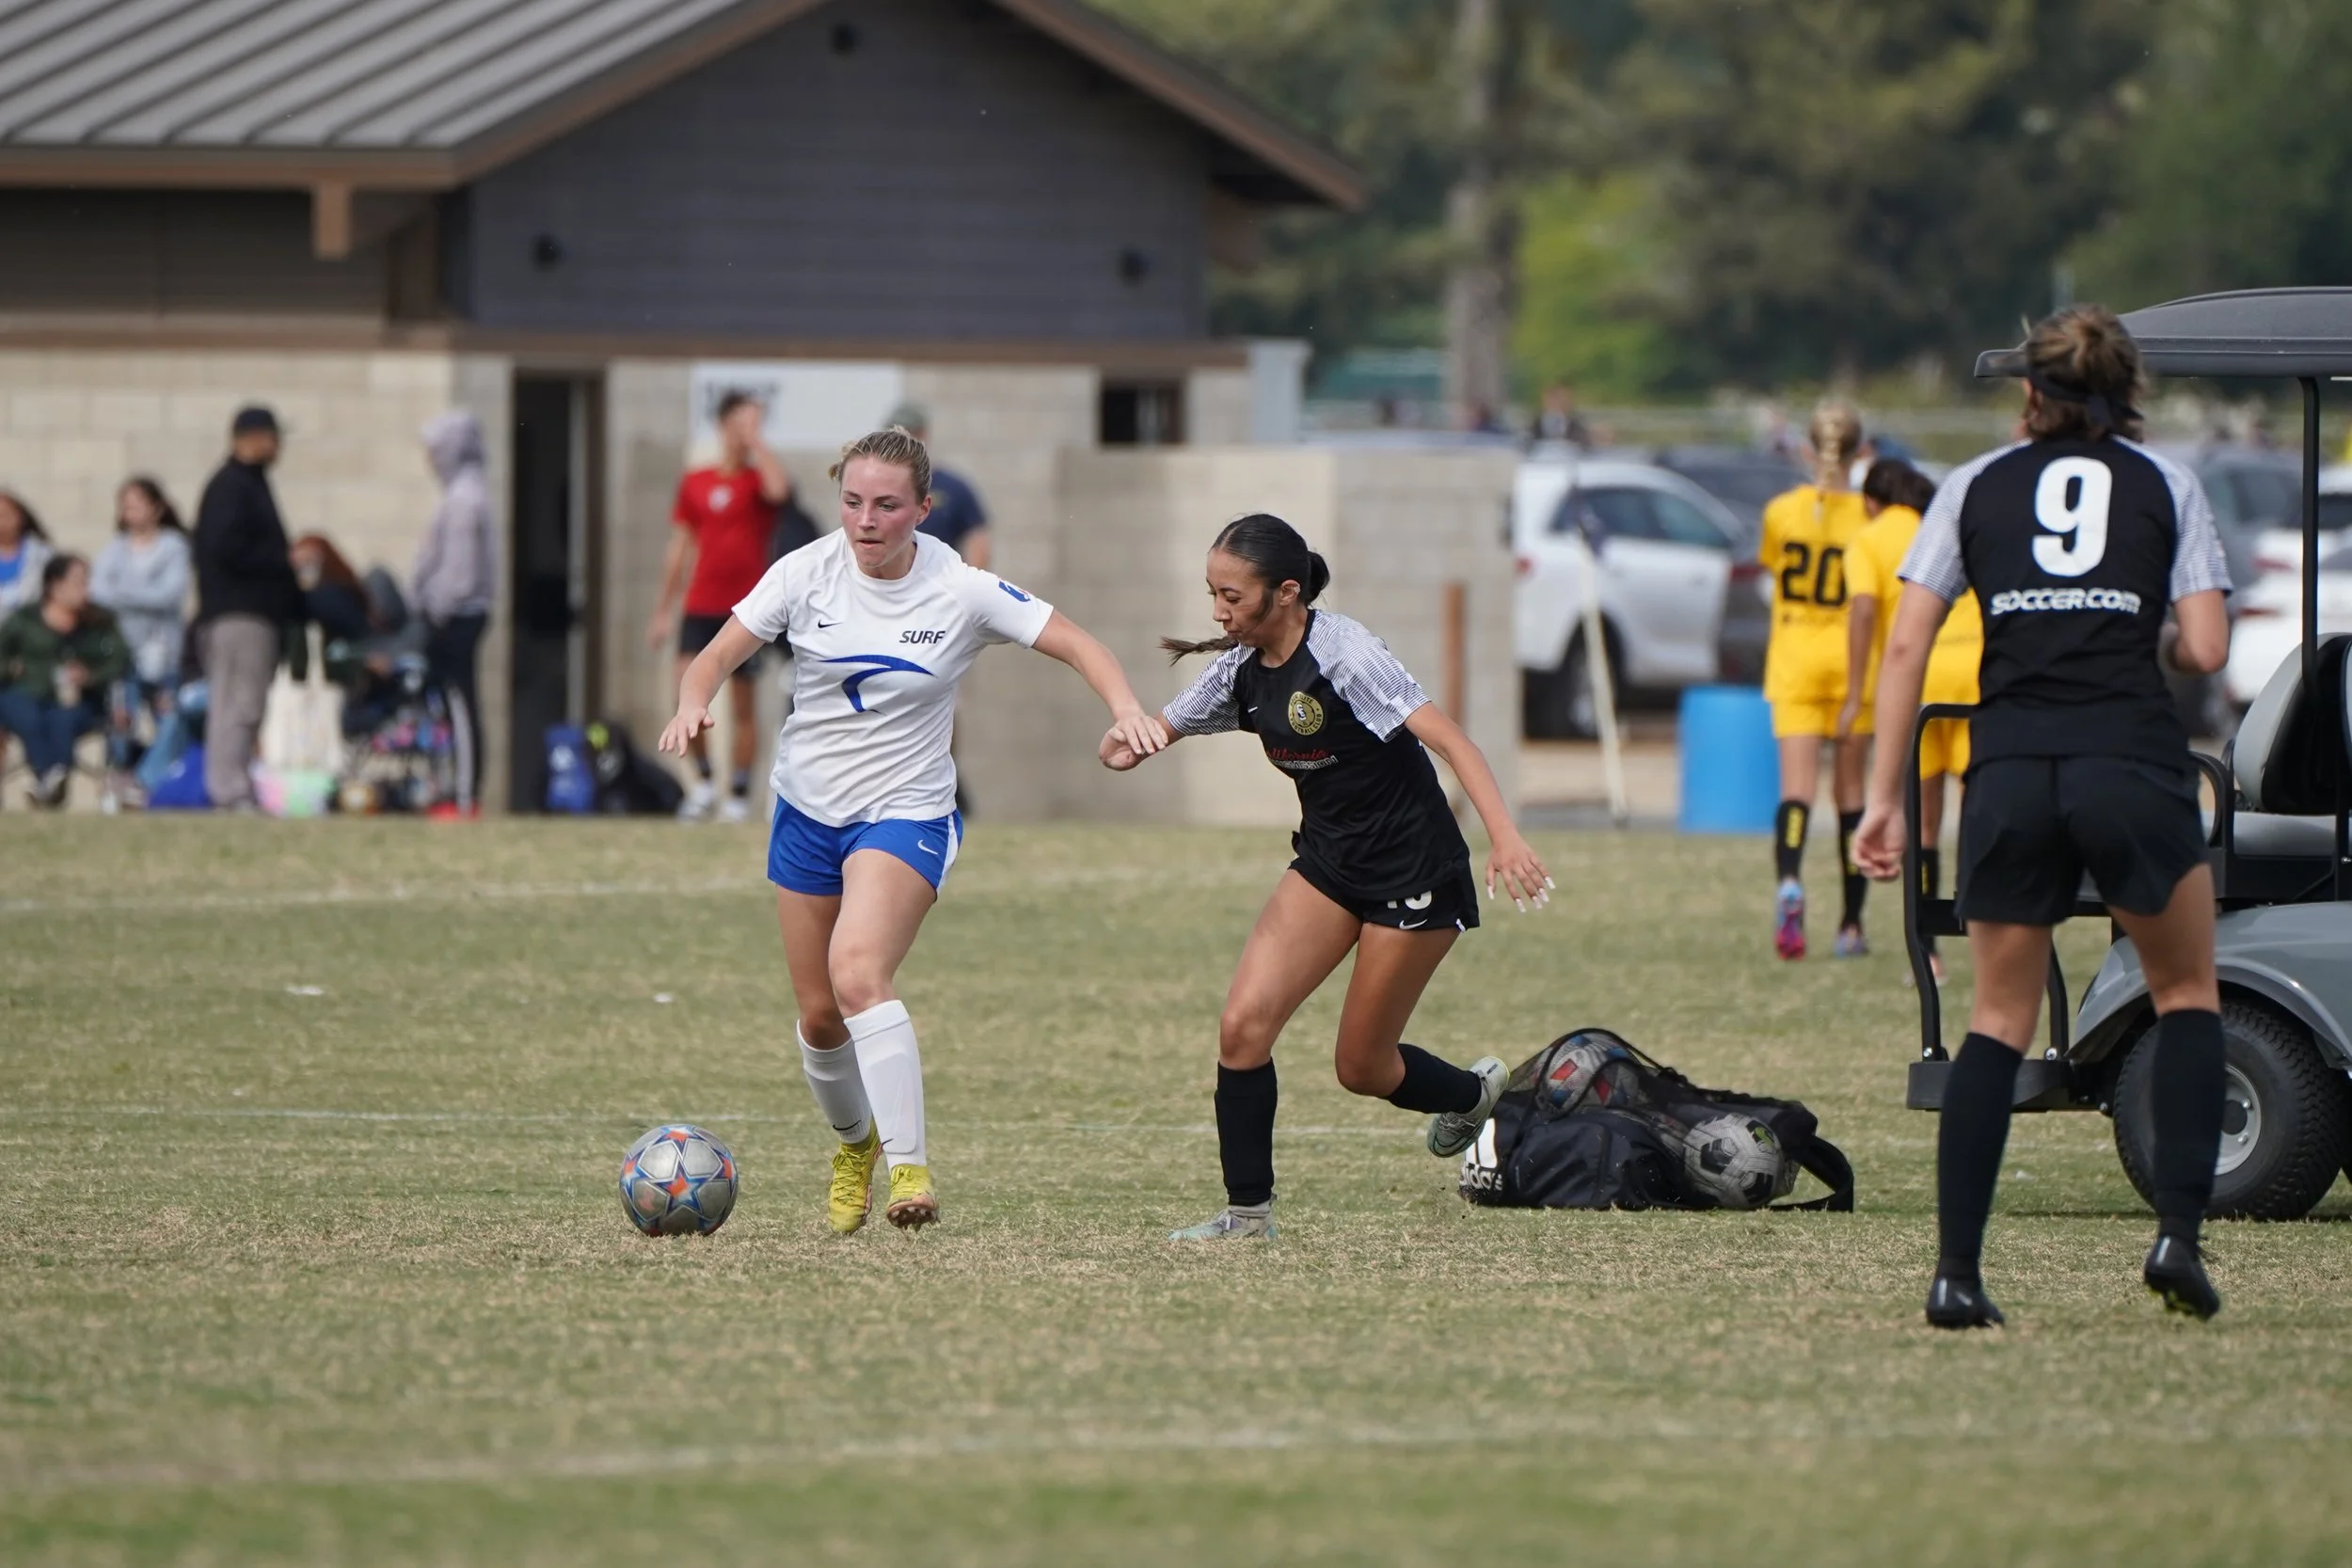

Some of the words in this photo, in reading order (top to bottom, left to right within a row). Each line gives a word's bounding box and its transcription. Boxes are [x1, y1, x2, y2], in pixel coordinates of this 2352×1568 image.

[2032, 456, 2113, 577] 9
[1782, 542, 1846, 607] 20
[898, 630, 946, 644] SURF
